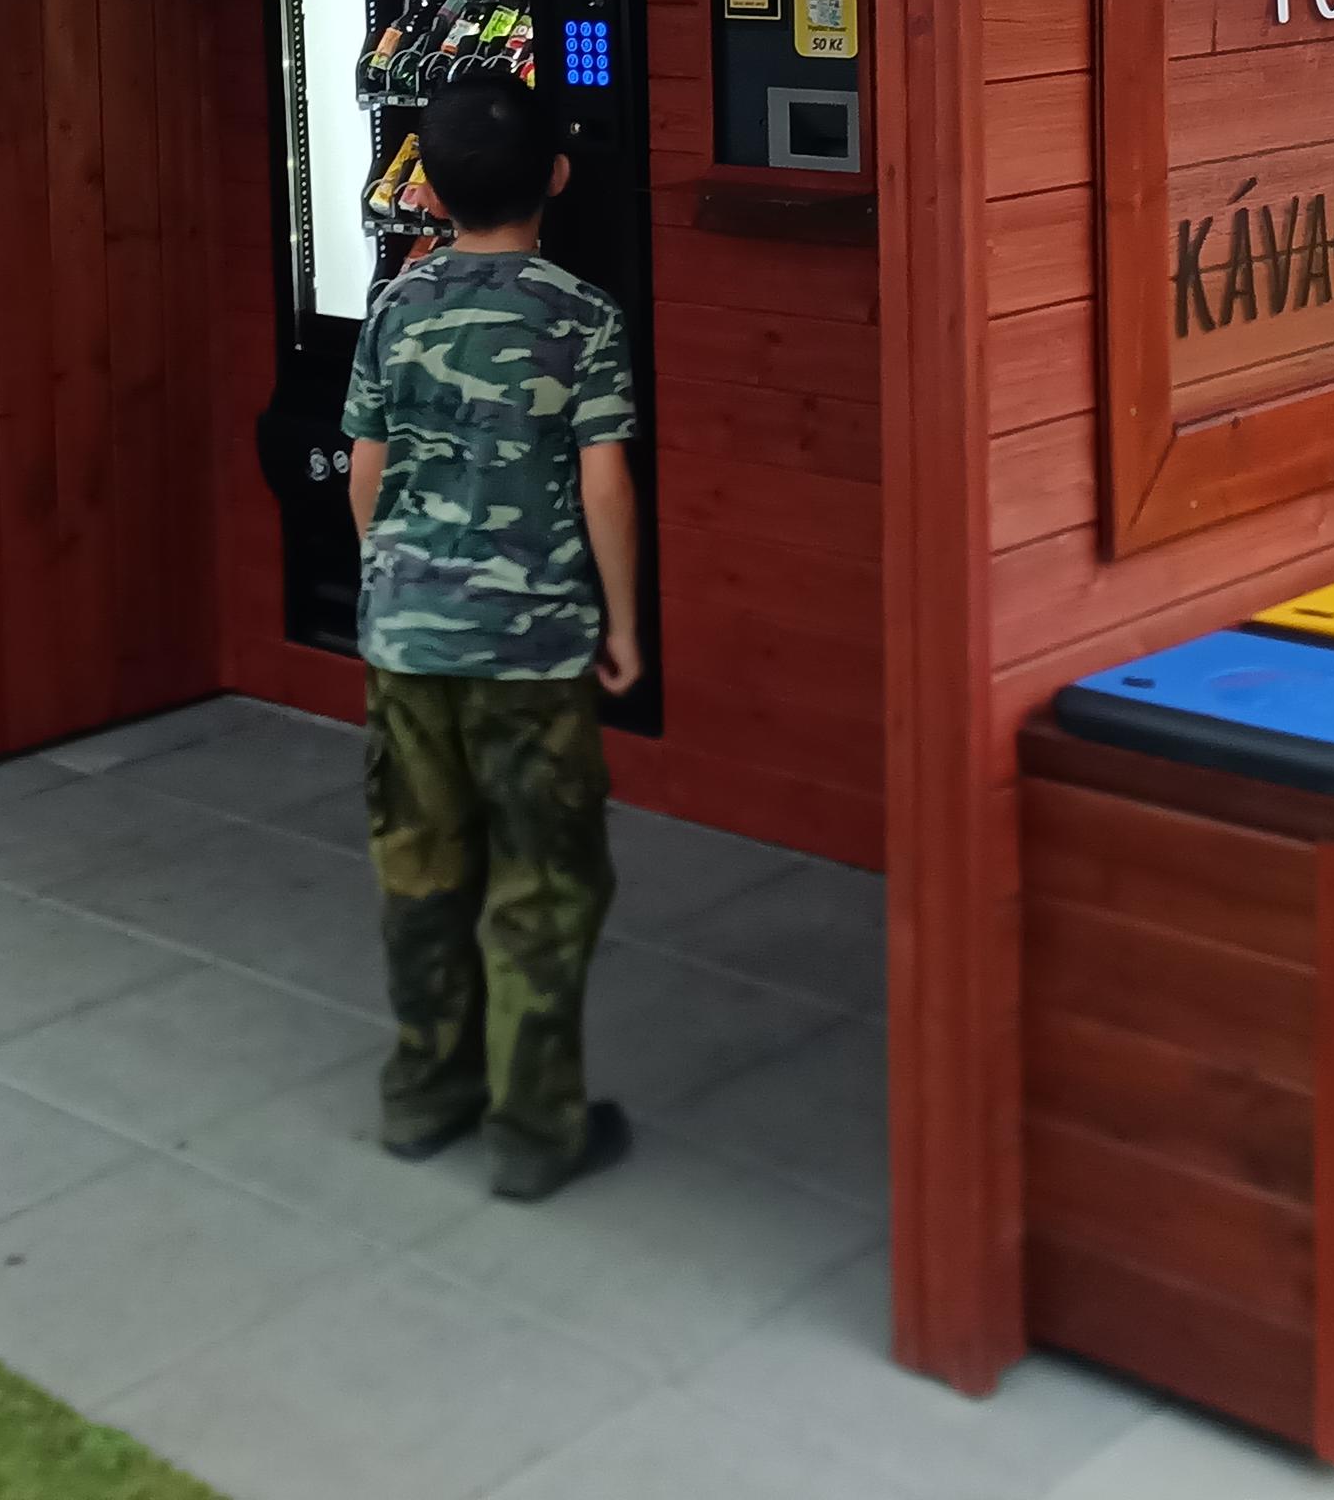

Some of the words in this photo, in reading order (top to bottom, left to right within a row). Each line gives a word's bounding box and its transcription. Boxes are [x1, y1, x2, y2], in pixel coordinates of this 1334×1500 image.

[812, 37, 827, 52] 50
[828, 37, 844, 52] Kč
[1177, 176, 1333, 338] KÁVA
